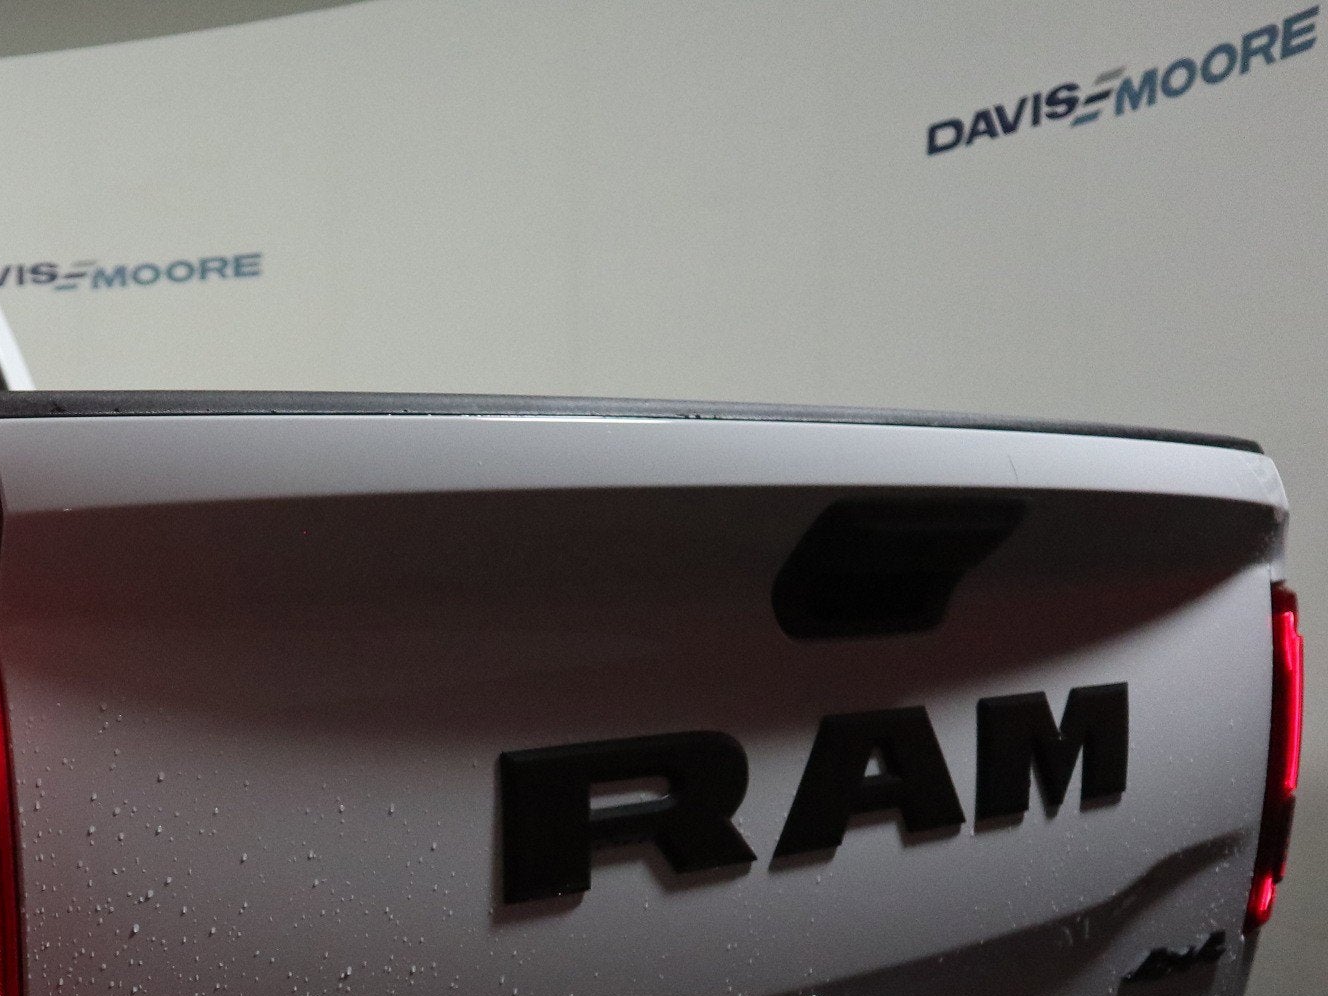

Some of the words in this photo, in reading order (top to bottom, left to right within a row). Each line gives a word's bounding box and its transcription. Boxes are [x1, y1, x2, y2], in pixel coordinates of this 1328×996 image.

[926, 82, 1080, 155] DAVIS
[1113, 5, 1320, 117] MOORE
[90, 252, 263, 289] MOORE
[499, 682, 1128, 903] RAM
